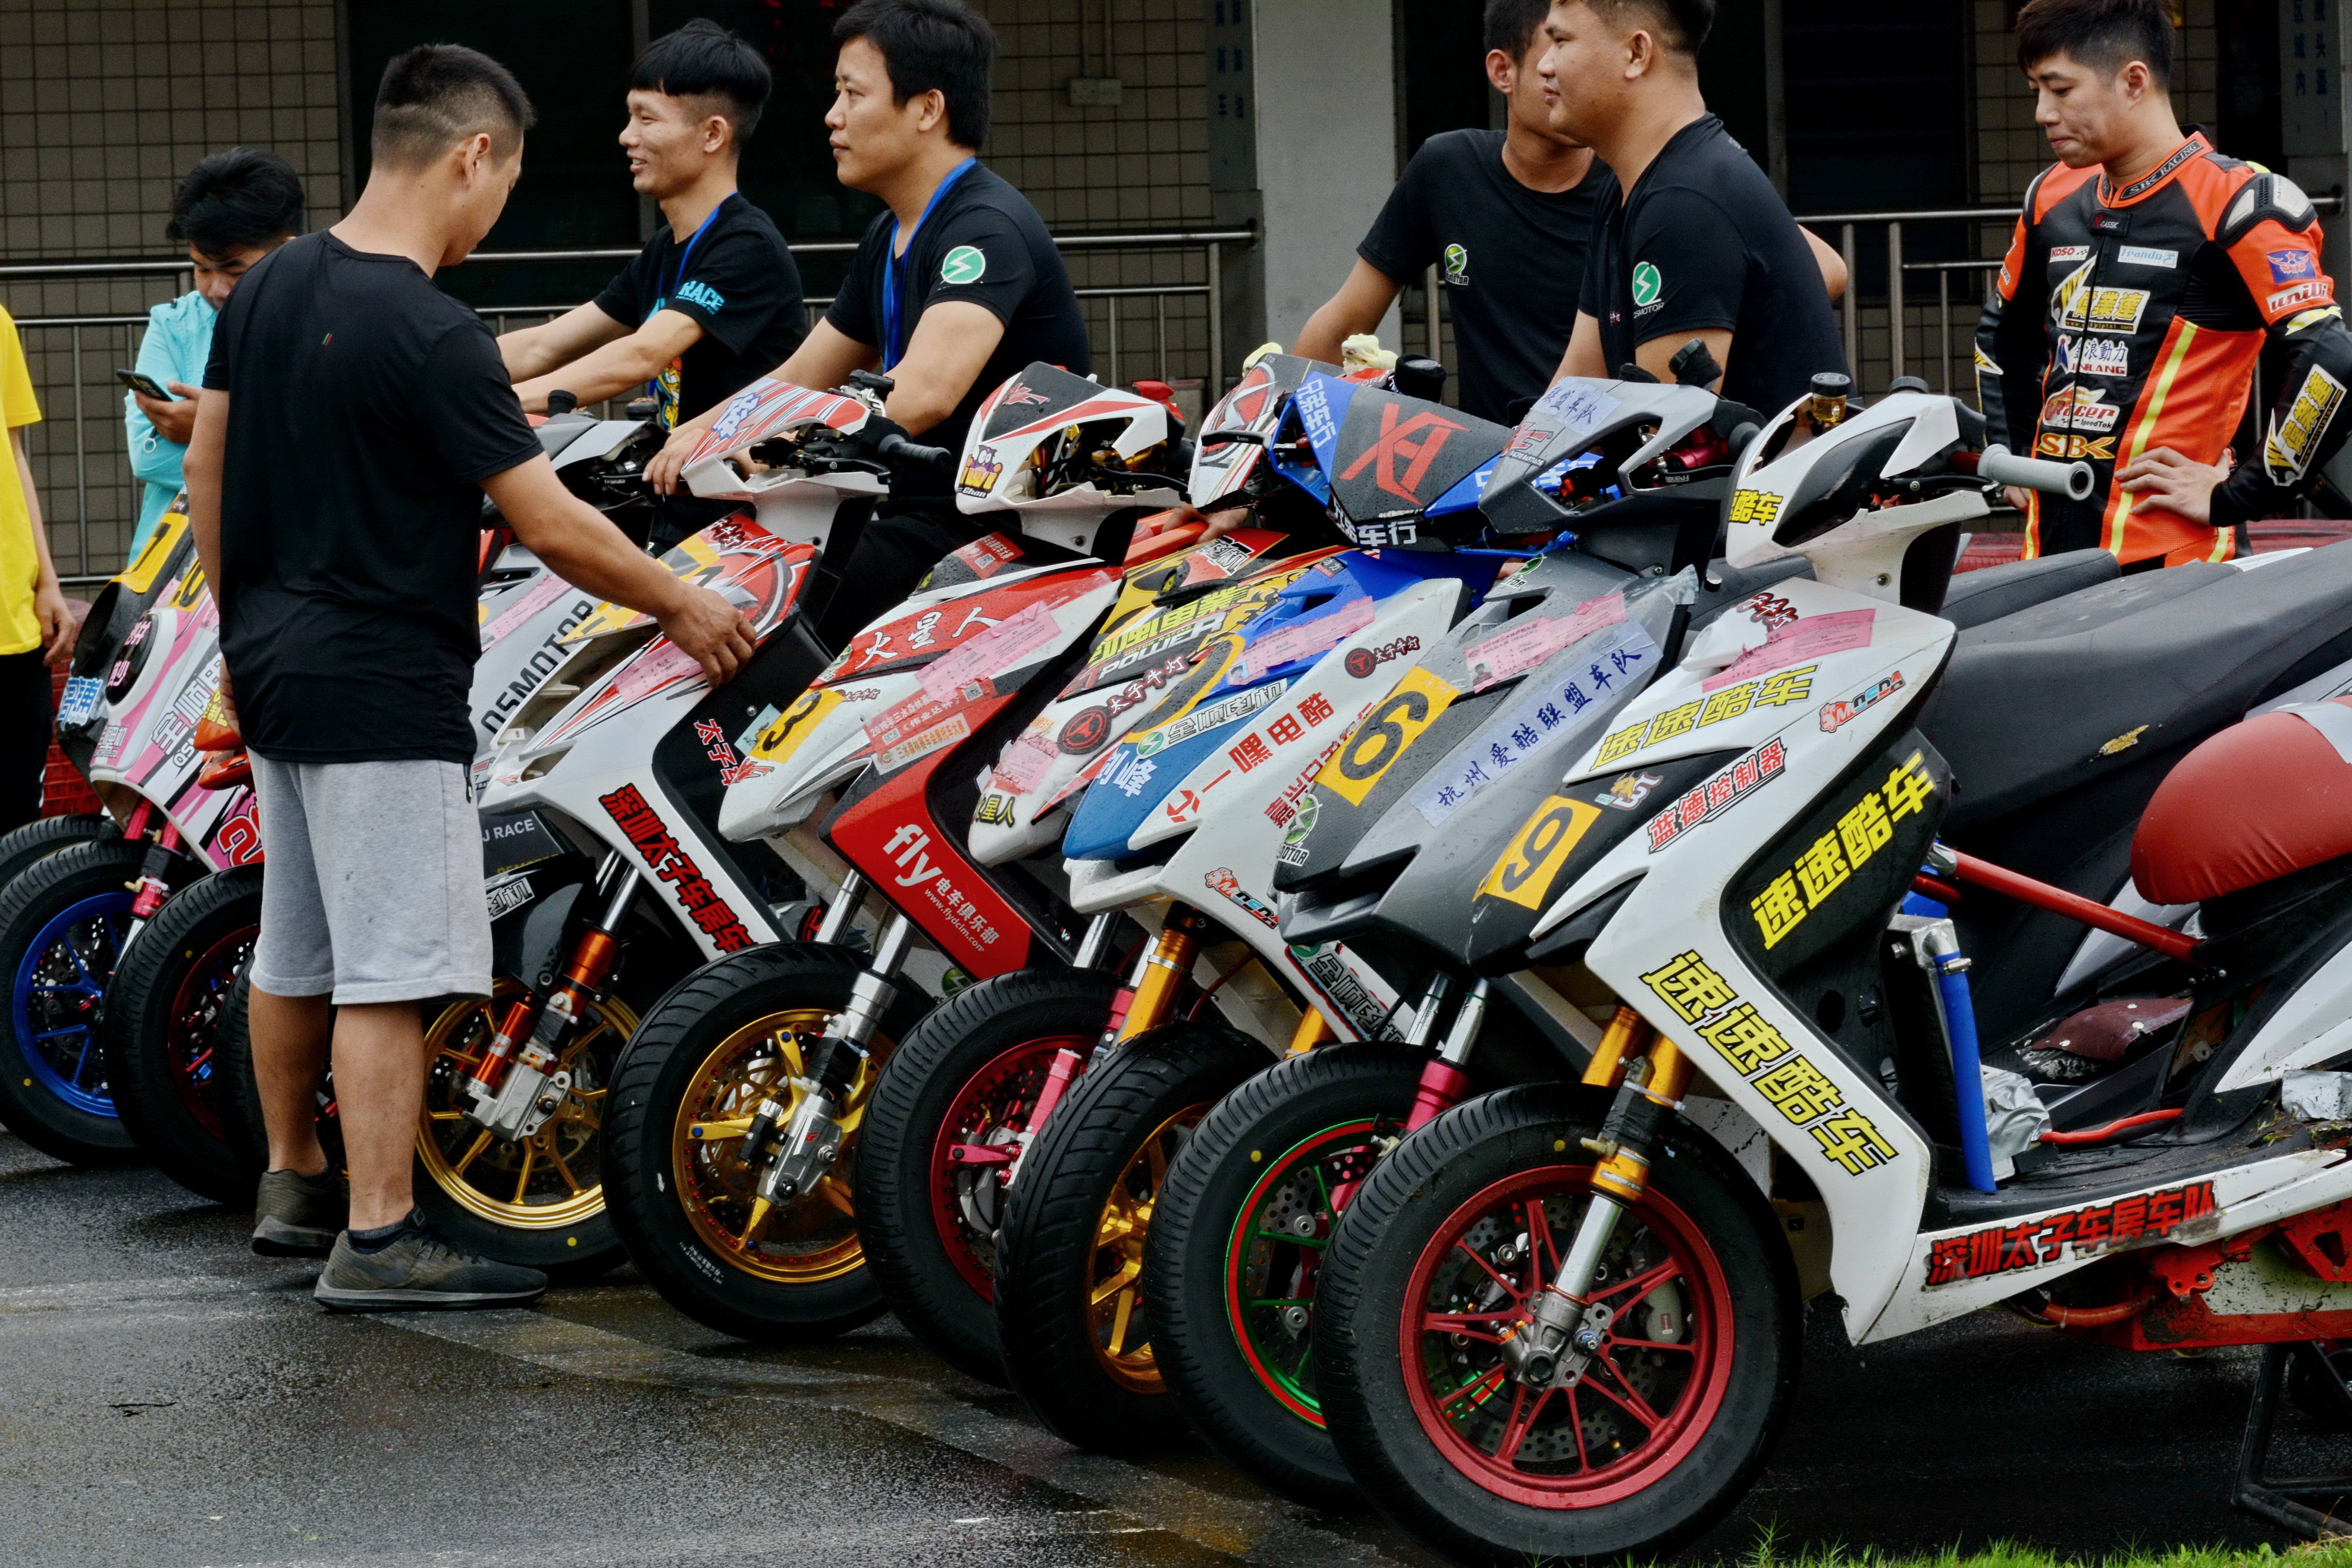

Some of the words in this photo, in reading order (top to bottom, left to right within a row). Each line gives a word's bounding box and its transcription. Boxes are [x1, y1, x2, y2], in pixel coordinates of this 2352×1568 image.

[2160, 142, 2197, 173] RACING
[2051, 248, 2075, 258] KOSO
[2120, 248, 2163, 261] Frando
[678, 280, 725, 312] RACE
[2036, 433, 2117, 459] SBK
[2080, 419, 2113, 429] SpeedTek
[962, 487, 987, 498] Chan
[1728, 489, 1784, 526] 酷车
[854, 606, 1003, 670] 火星人
[1098, 611, 1228, 680] POWER
[1375, 637, 1418, 662] 太子牛灯
[1109, 655, 1185, 715] 太子牛灯
[1168, 682, 1283, 745] 全顺电机
[761, 690, 823, 752] 3
[1339, 690, 1429, 781] 6
[1589, 666, 1819, 771] 速速酷车
[1650, 743, 1784, 849] 蓝德控制器
[493, 819, 535, 840] RACE
[883, 824, 943, 887] fly
[1501, 806, 1573, 892] 9
[1750, 752, 1935, 952] 速速酷车
[924, 888, 985, 952] www.flydclm.com
[935, 877, 1000, 945] 电车俱乐部
[1638, 948, 1900, 1177] 速速酷车
[1929, 1182, 2216, 1286] 深圳太子车房车队
